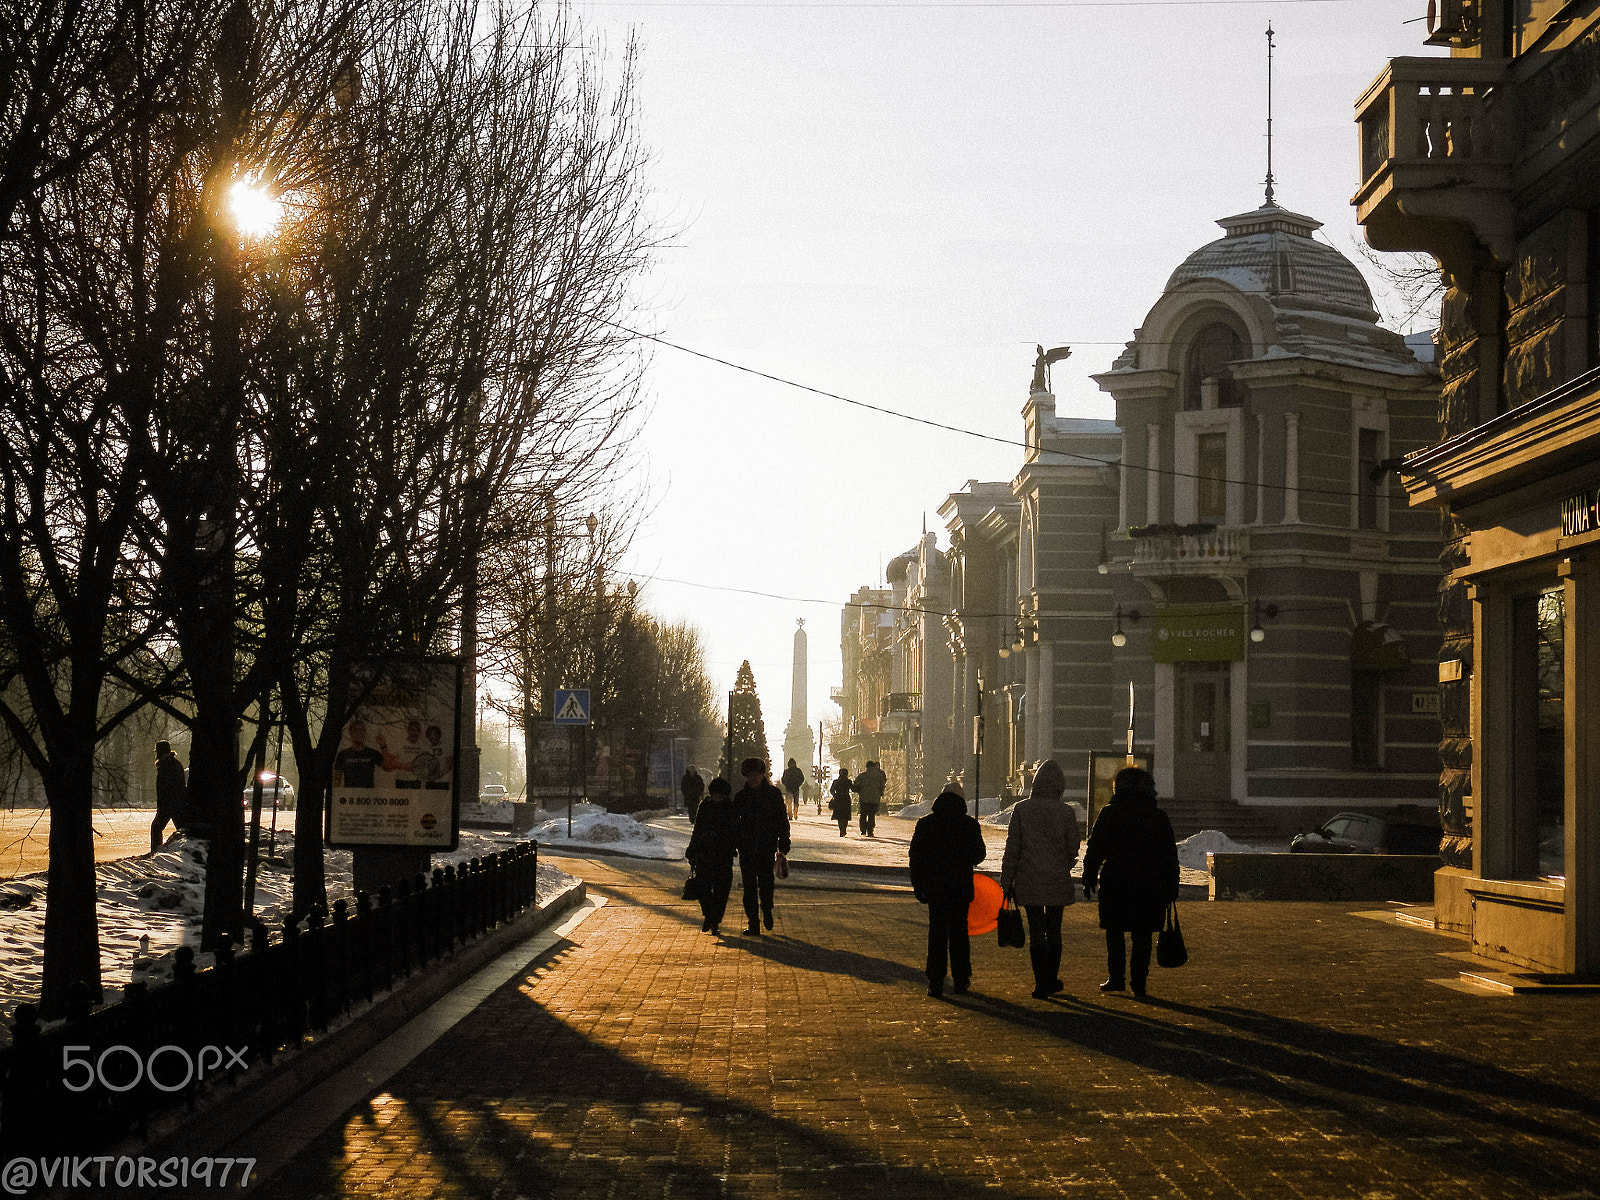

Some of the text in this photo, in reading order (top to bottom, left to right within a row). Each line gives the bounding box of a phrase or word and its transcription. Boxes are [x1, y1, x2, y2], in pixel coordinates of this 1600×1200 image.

[1171, 628, 1235, 638] YVES ROCHER
[349, 797, 410, 806] 8 800 700 8000
